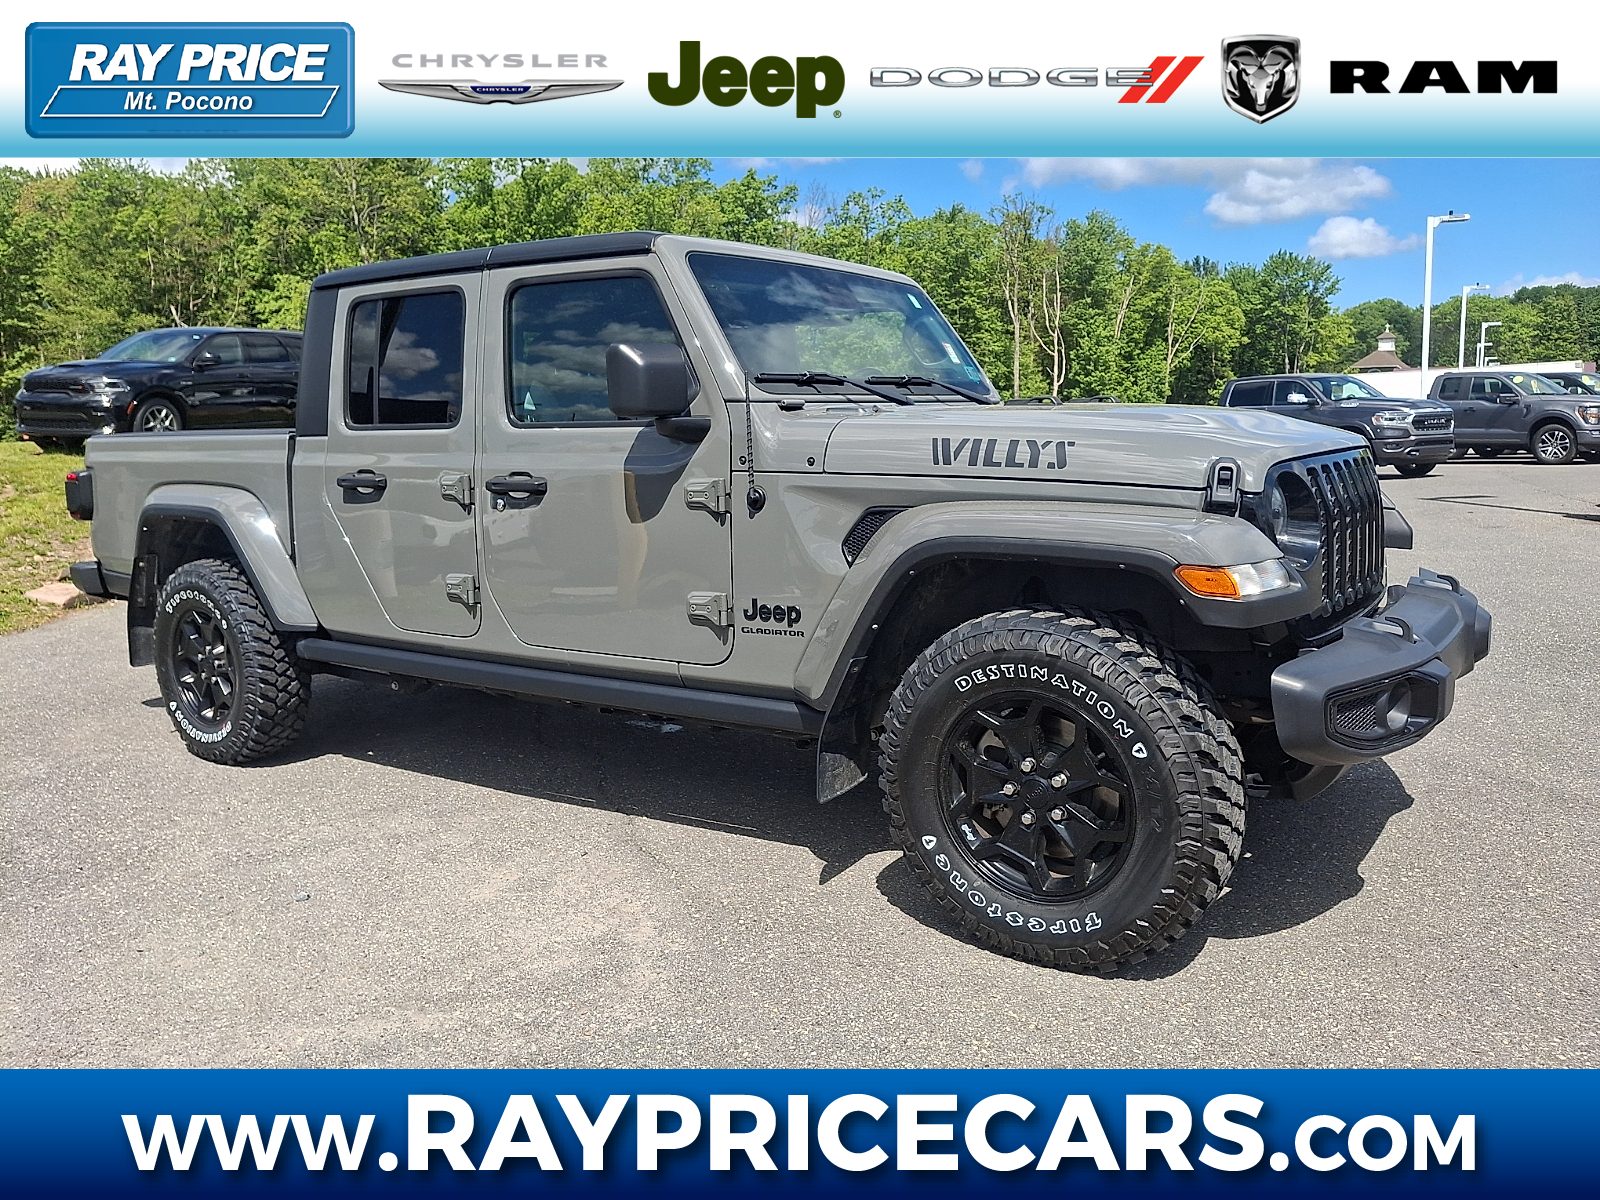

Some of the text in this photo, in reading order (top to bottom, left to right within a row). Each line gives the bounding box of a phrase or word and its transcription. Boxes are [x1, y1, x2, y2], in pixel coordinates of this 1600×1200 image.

[931, 437, 1076, 470] WILLYS
[743, 598, 802, 628] Jeep
[741, 626, 805, 638] GLADIATOR
[954, 663, 1135, 739] DESTINATION
